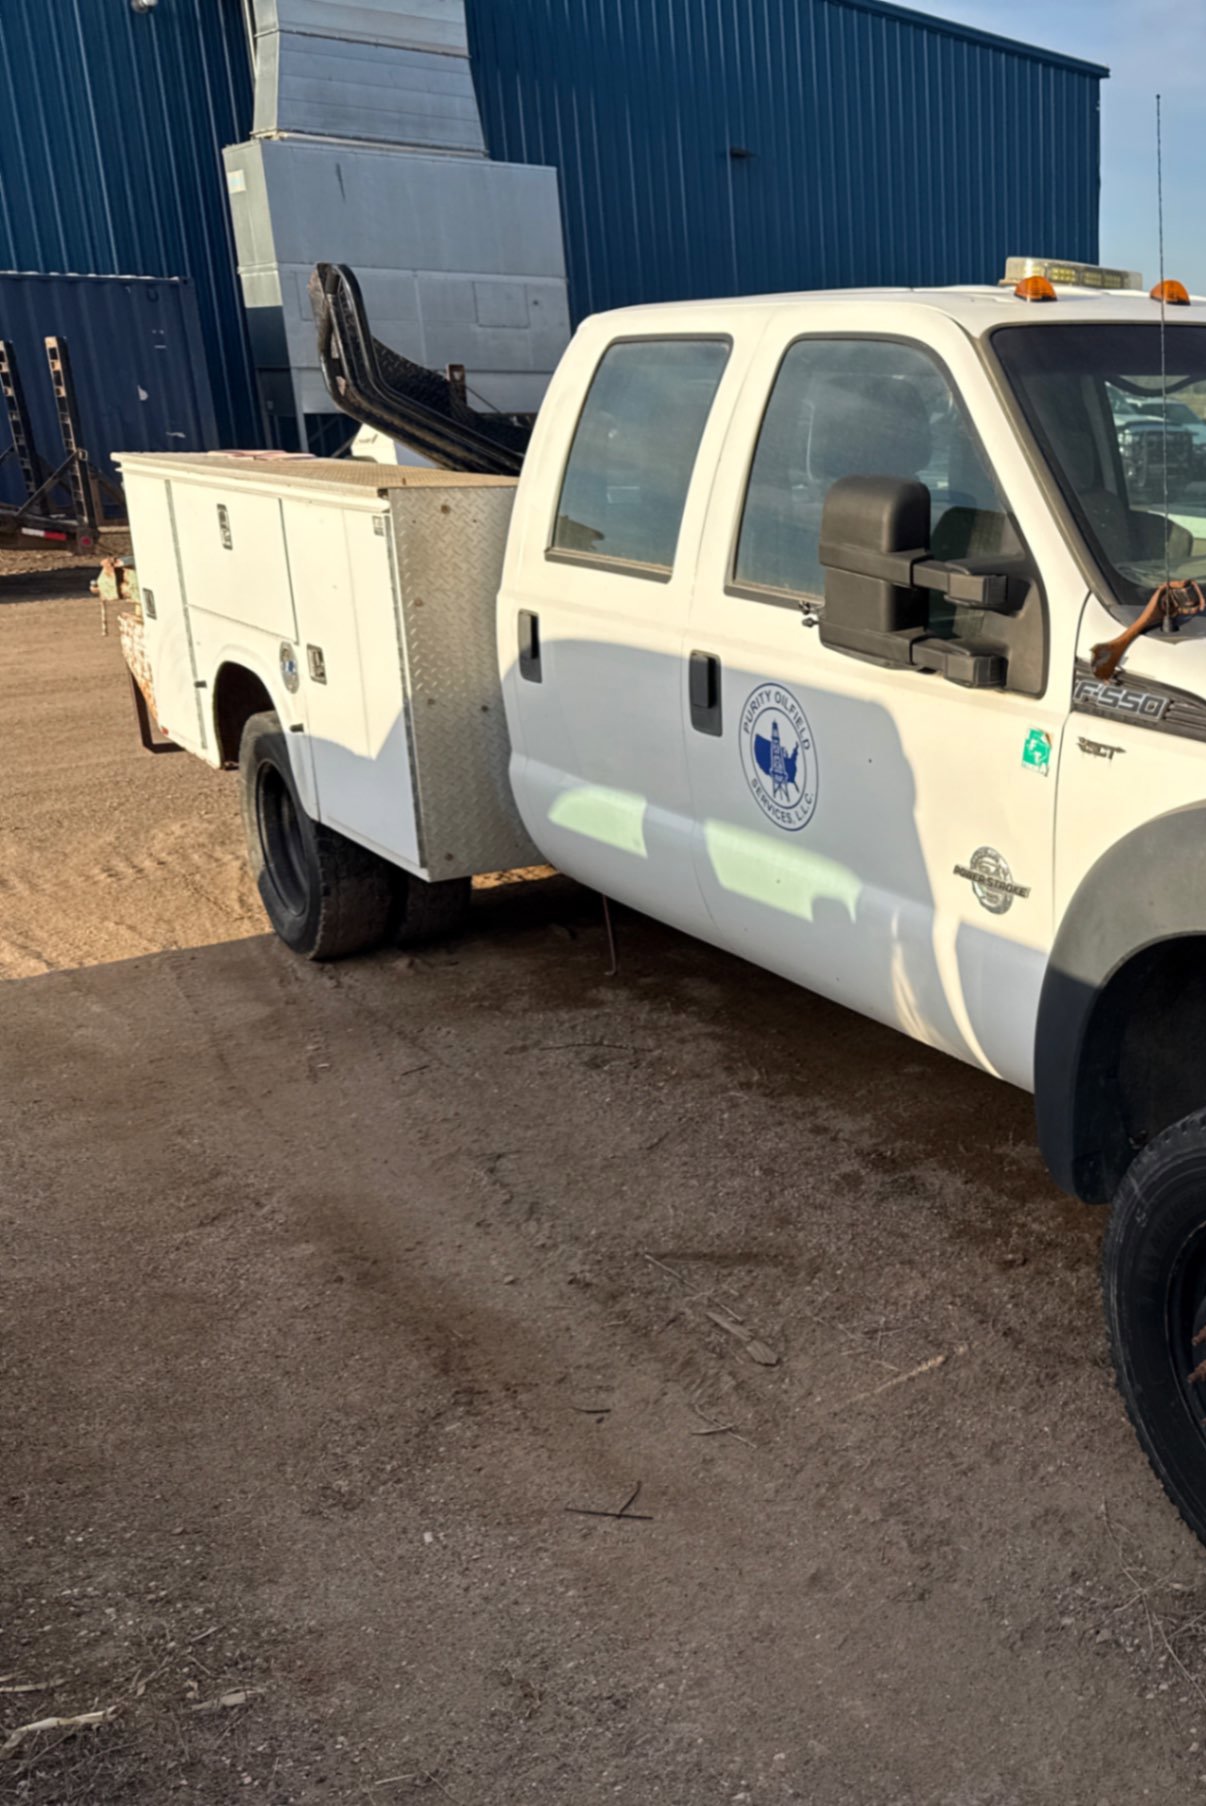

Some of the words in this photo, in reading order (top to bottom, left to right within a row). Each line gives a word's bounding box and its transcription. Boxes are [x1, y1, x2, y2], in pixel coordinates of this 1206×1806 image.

[743, 690, 771, 734] PURITY
[775, 691, 811, 750] OILFIELD
[953, 865, 986, 884] POWER
[987, 877, 1027, 898] STROKE
